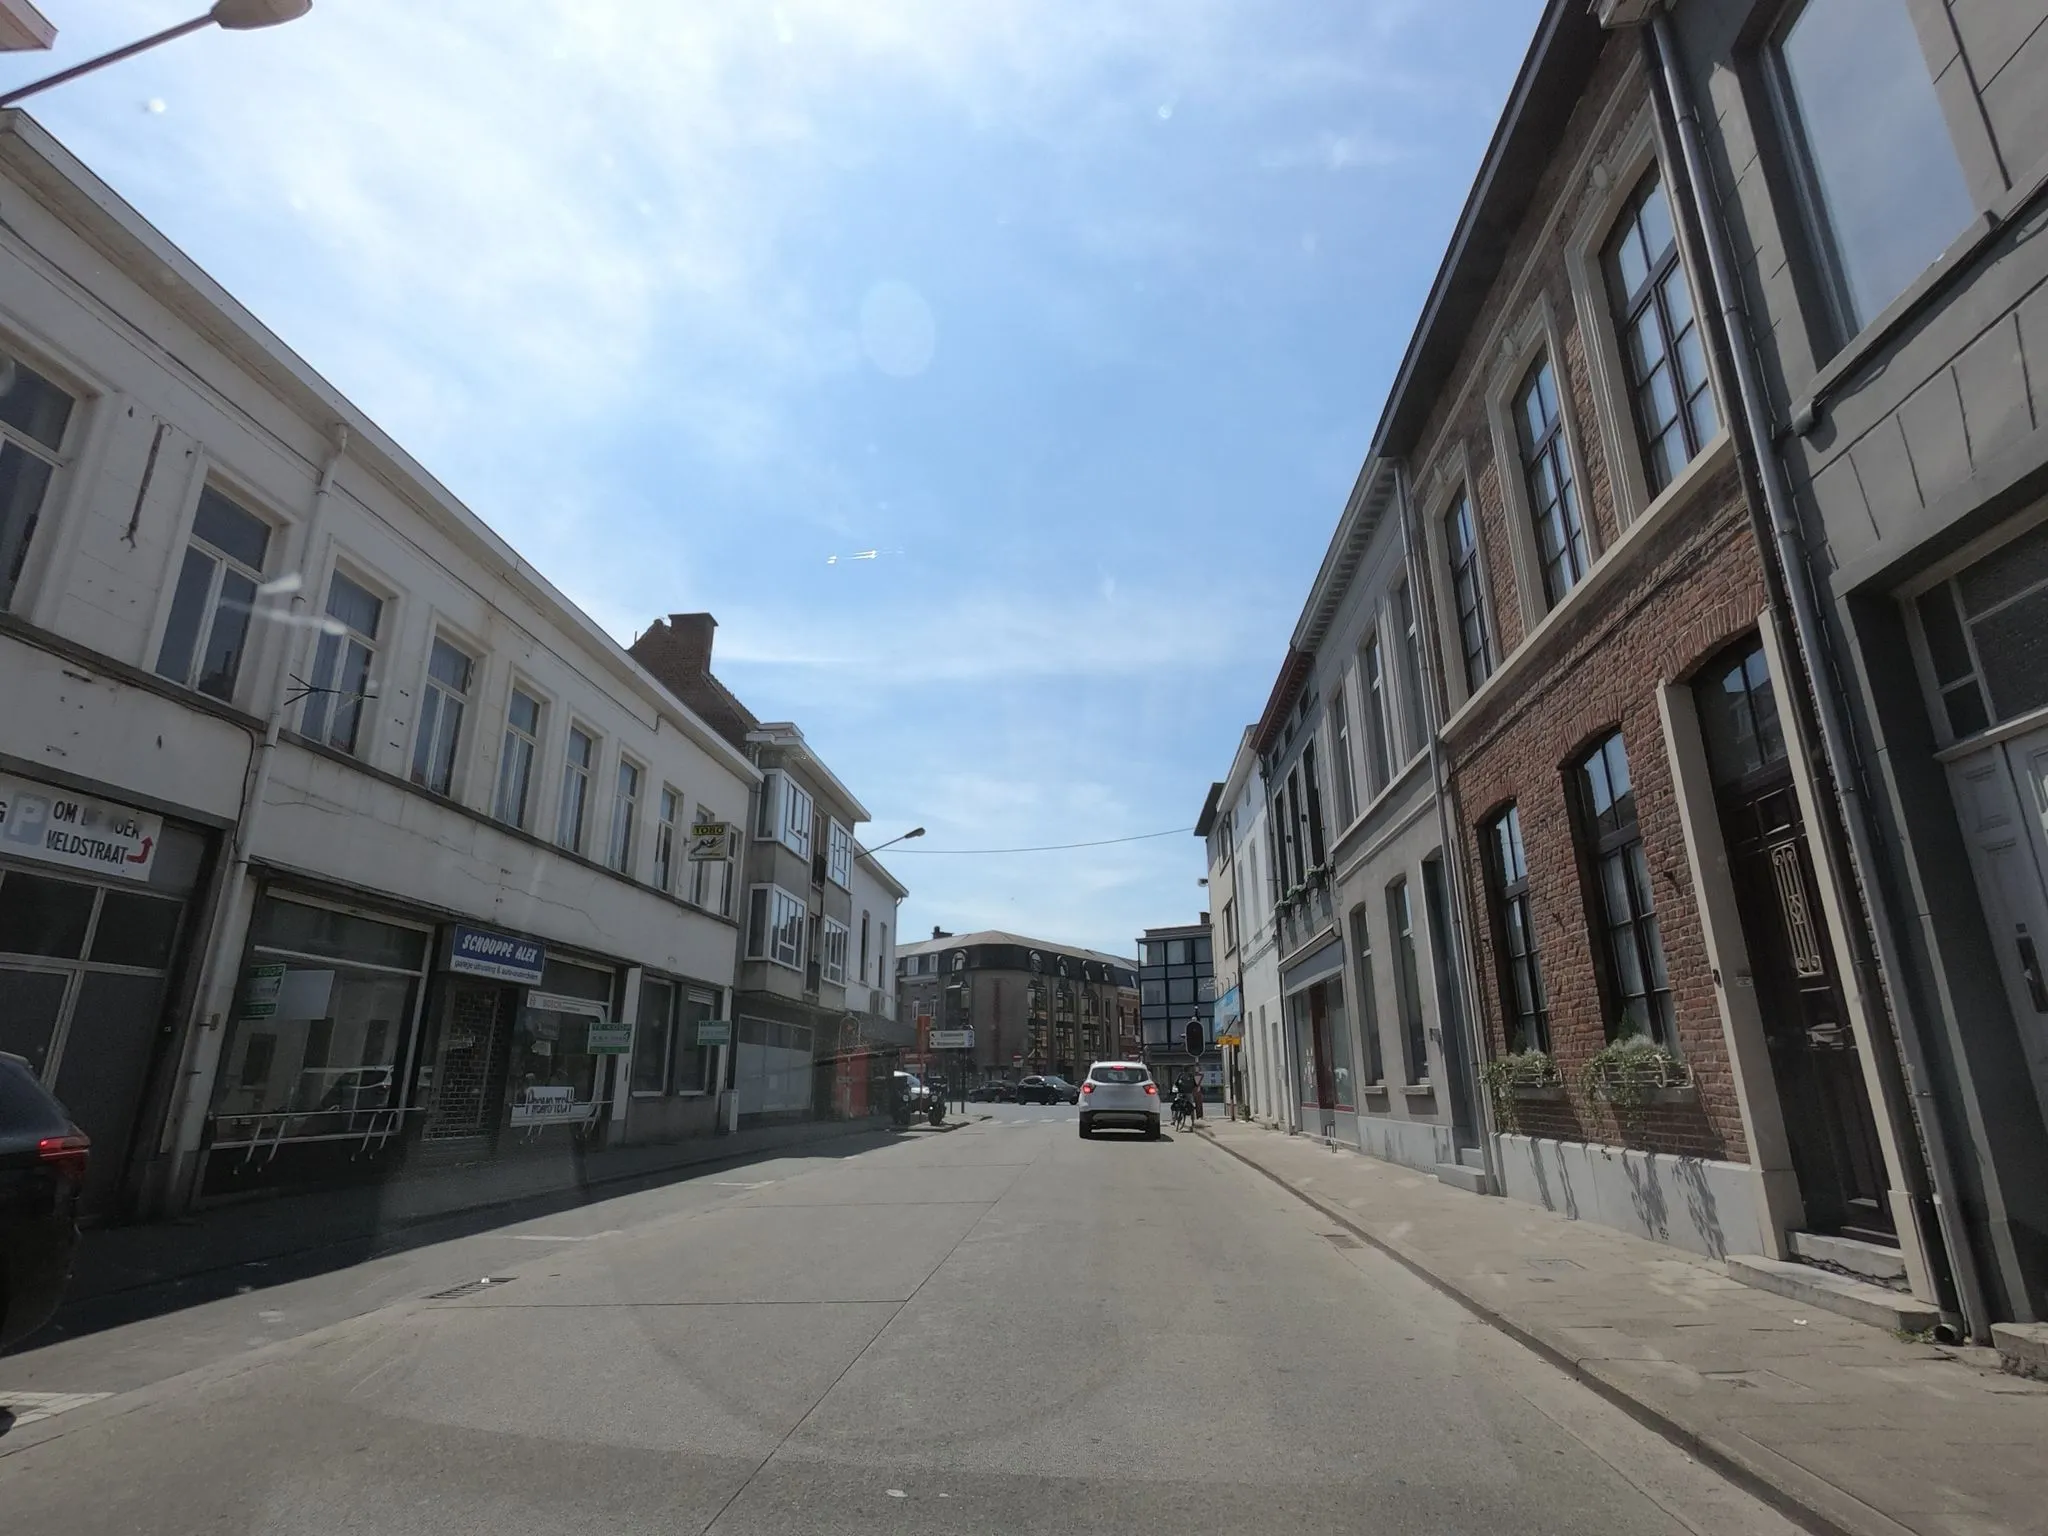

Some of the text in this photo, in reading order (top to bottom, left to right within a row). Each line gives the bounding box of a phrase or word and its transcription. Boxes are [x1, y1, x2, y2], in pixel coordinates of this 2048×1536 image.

[53, 800, 78, 824] OM
[46, 829, 129, 865] VELDSTRAAT
[462, 934, 538, 963] SCHOUPPE ALEX
